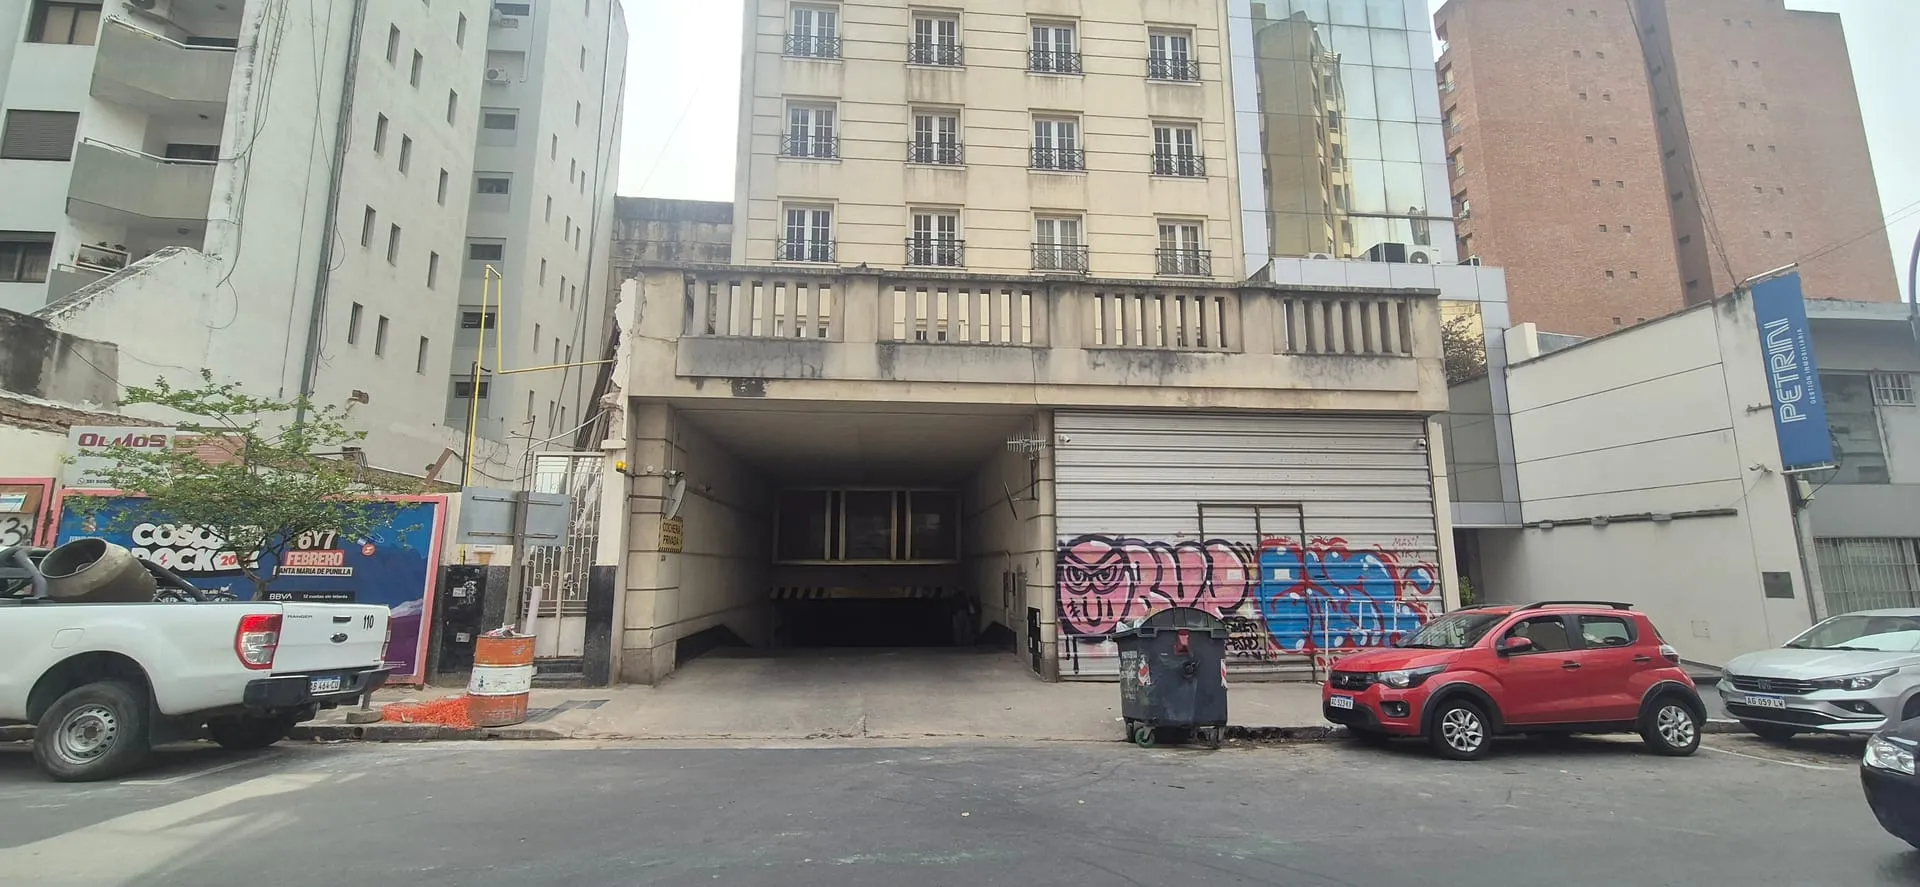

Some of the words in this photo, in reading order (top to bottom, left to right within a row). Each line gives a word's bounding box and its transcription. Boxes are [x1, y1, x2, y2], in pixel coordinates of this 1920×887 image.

[1797, 328, 1811, 375] INMOBILIARIA
[1763, 317, 1807, 424] PETRINI
[662, 522, 681, 534] COCHERA
[662, 534, 679, 546] PRIVADA
[286, 552, 344, 566] FEBRERO
[277, 567, 296, 575] ANTA
[362, 614, 375, 629] 110
[1758, 698, 1772, 706] 059
